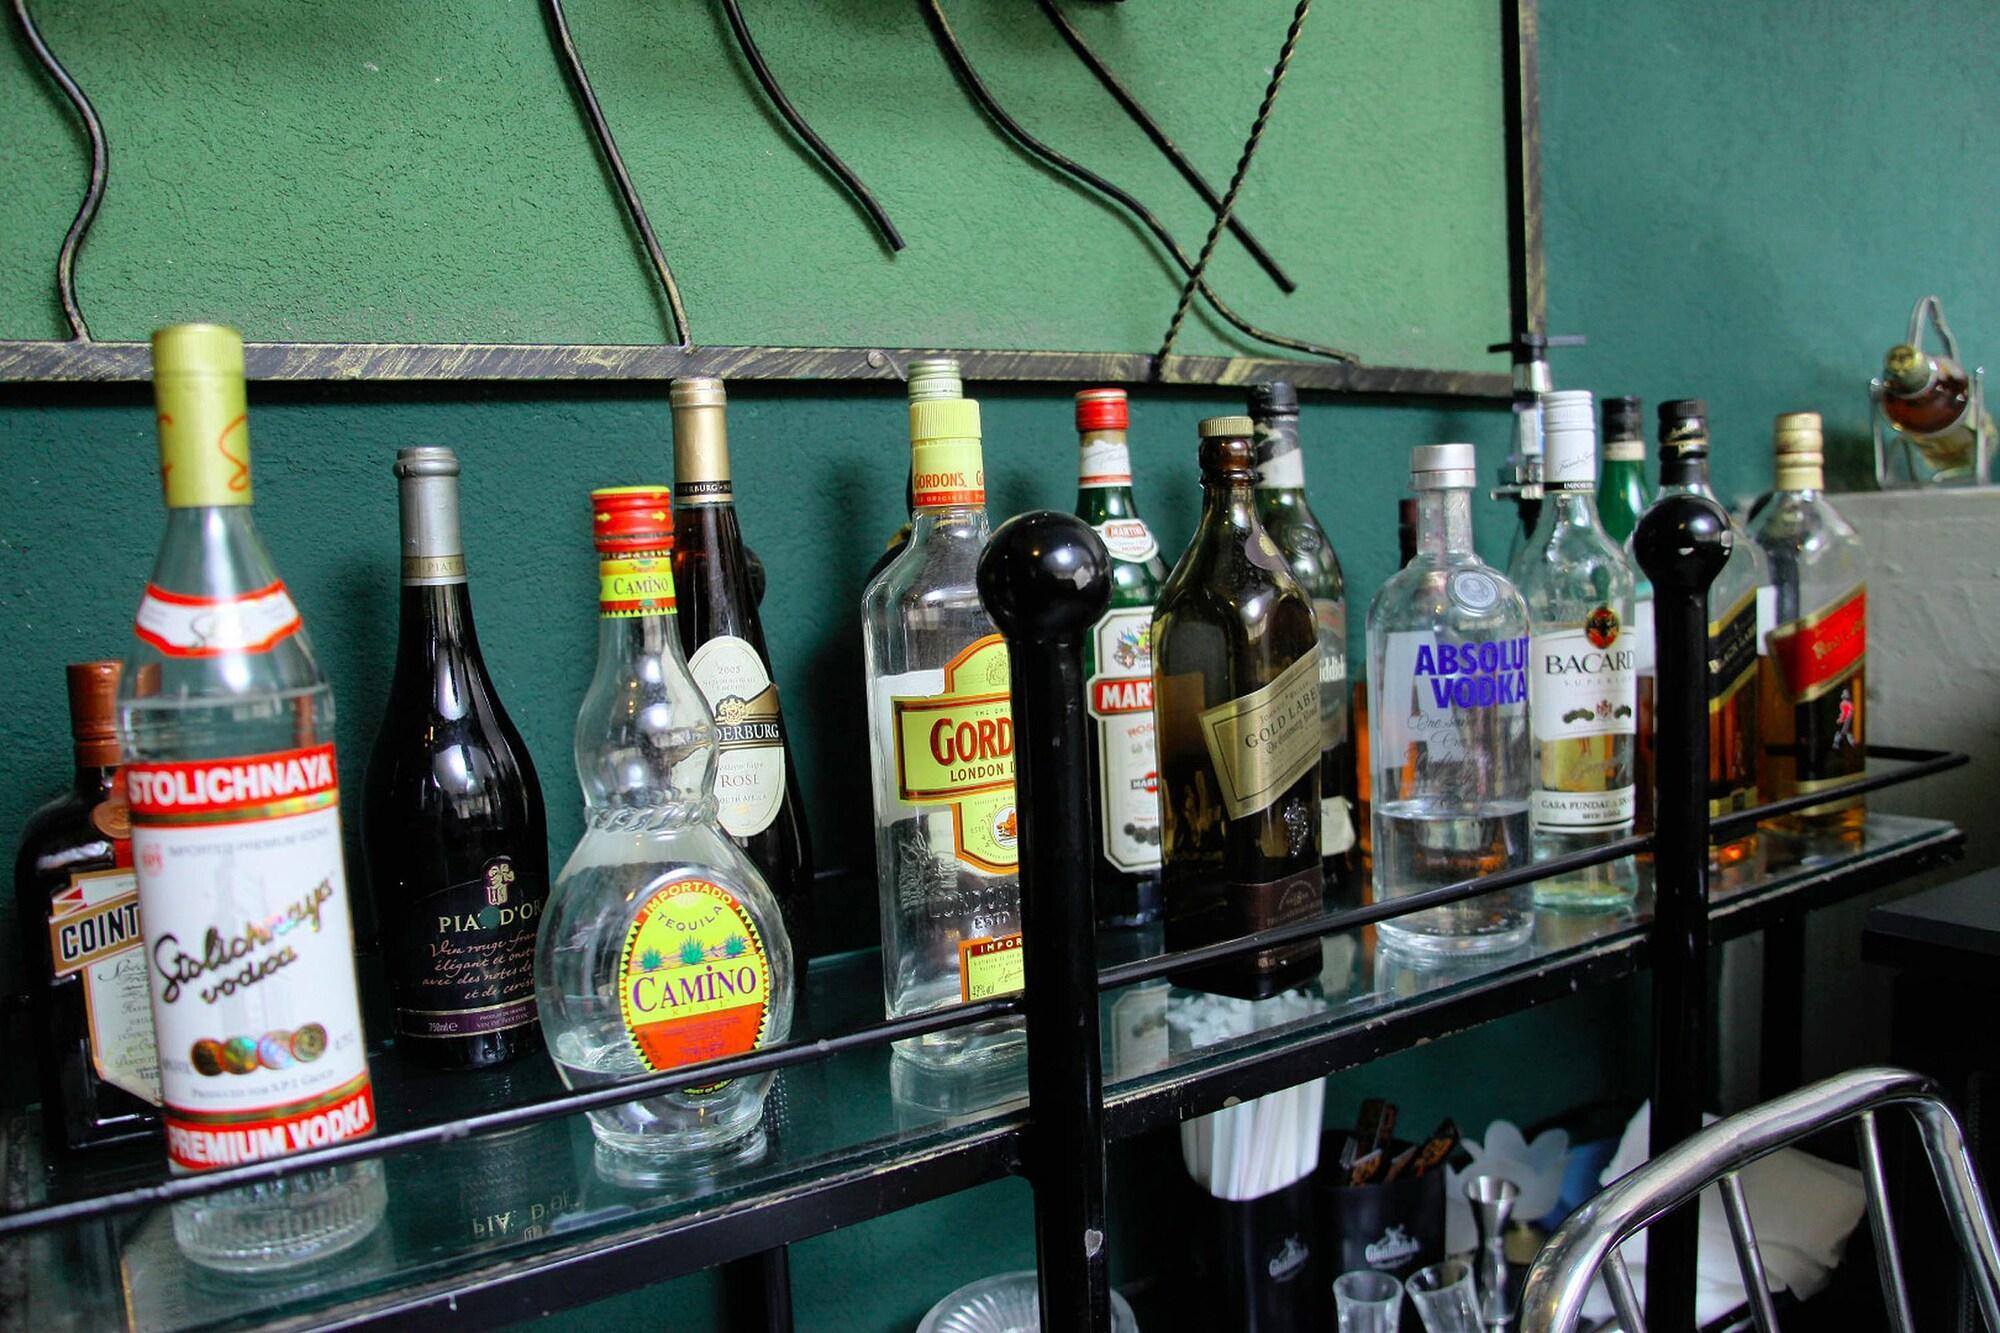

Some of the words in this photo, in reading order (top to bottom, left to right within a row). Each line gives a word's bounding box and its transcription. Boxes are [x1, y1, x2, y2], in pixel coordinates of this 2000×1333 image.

[1430, 671, 1528, 709] VODKA
[1244, 714, 1287, 750] GOLD
[128, 753, 333, 807] STOLICHNAYA
[950, 762, 1004, 782] LONDON
[643, 881, 733, 915] IMPORTADO
[438, 914, 486, 933] PIA
[658, 905, 723, 931] TEQUILA
[168, 1122, 288, 1166] PREMIUM
[287, 1095, 371, 1151] VODKA
